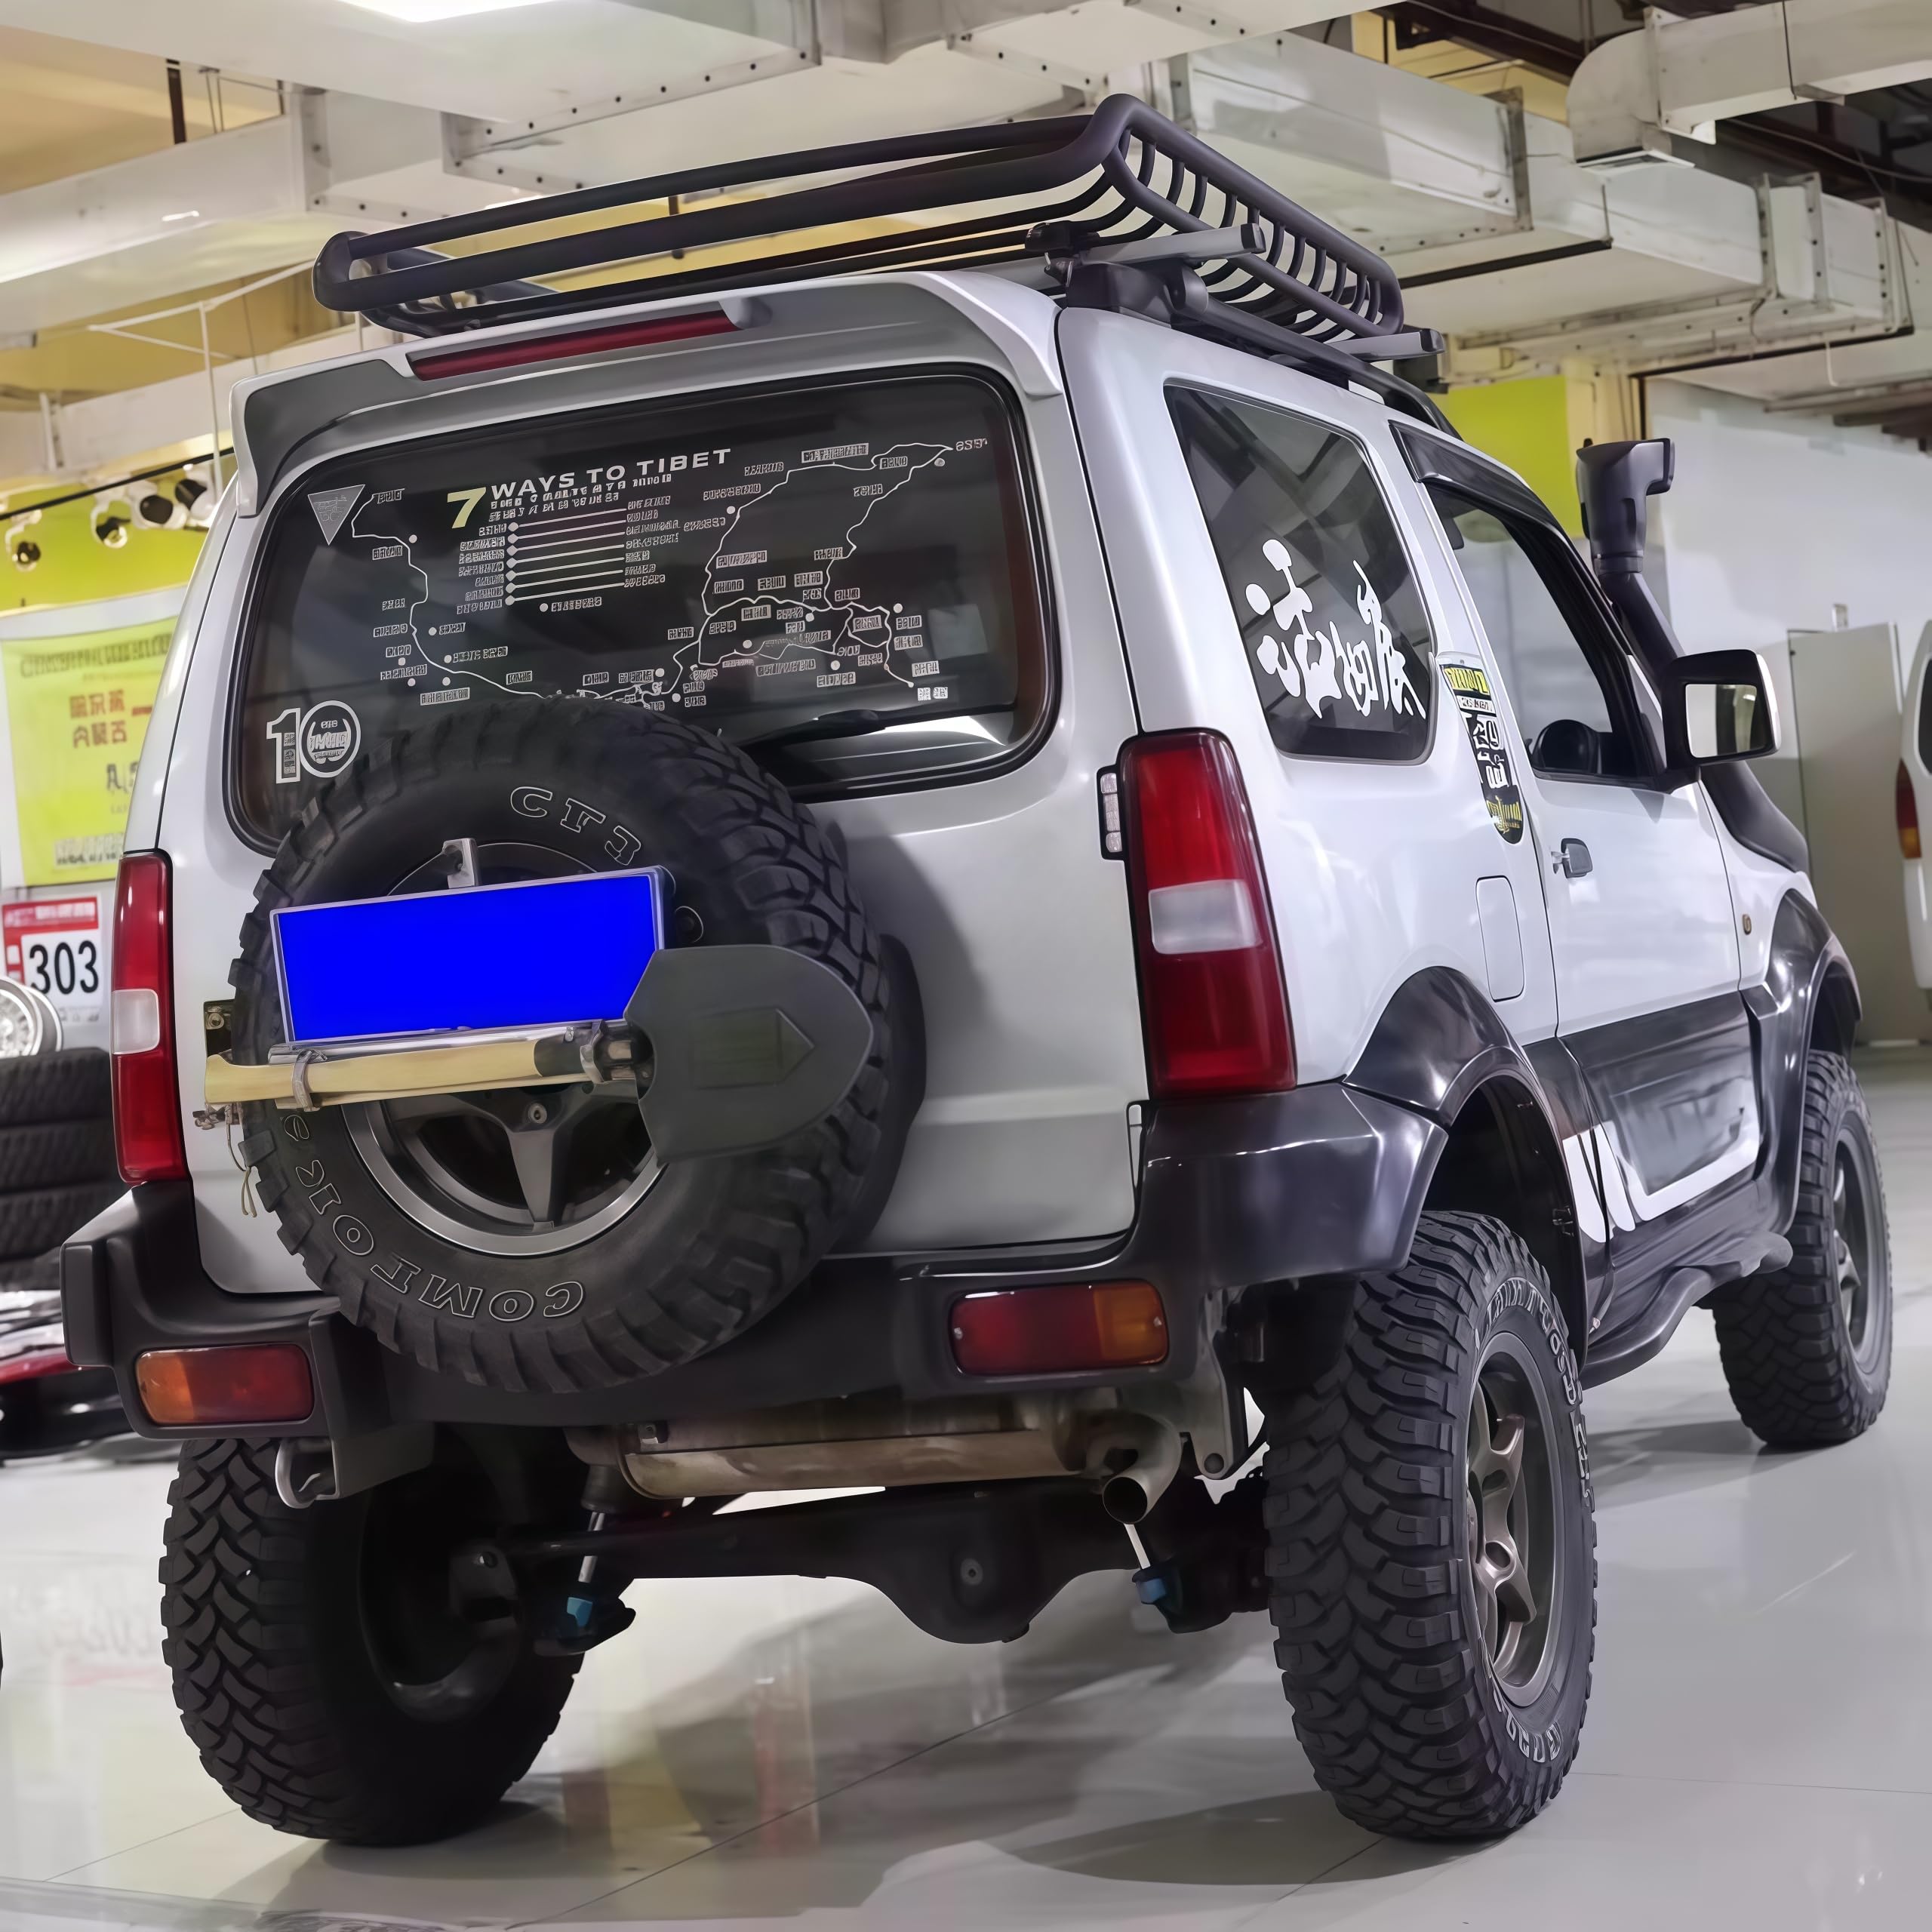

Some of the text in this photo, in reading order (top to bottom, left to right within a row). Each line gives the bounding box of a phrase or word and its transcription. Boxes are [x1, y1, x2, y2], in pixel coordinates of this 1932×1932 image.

[446, 488, 487, 529] 7
[491, 472, 575, 500] WAYS
[586, 465, 626, 484] TO
[636, 448, 731, 475] TIBET
[29, 940, 99, 995] 303
